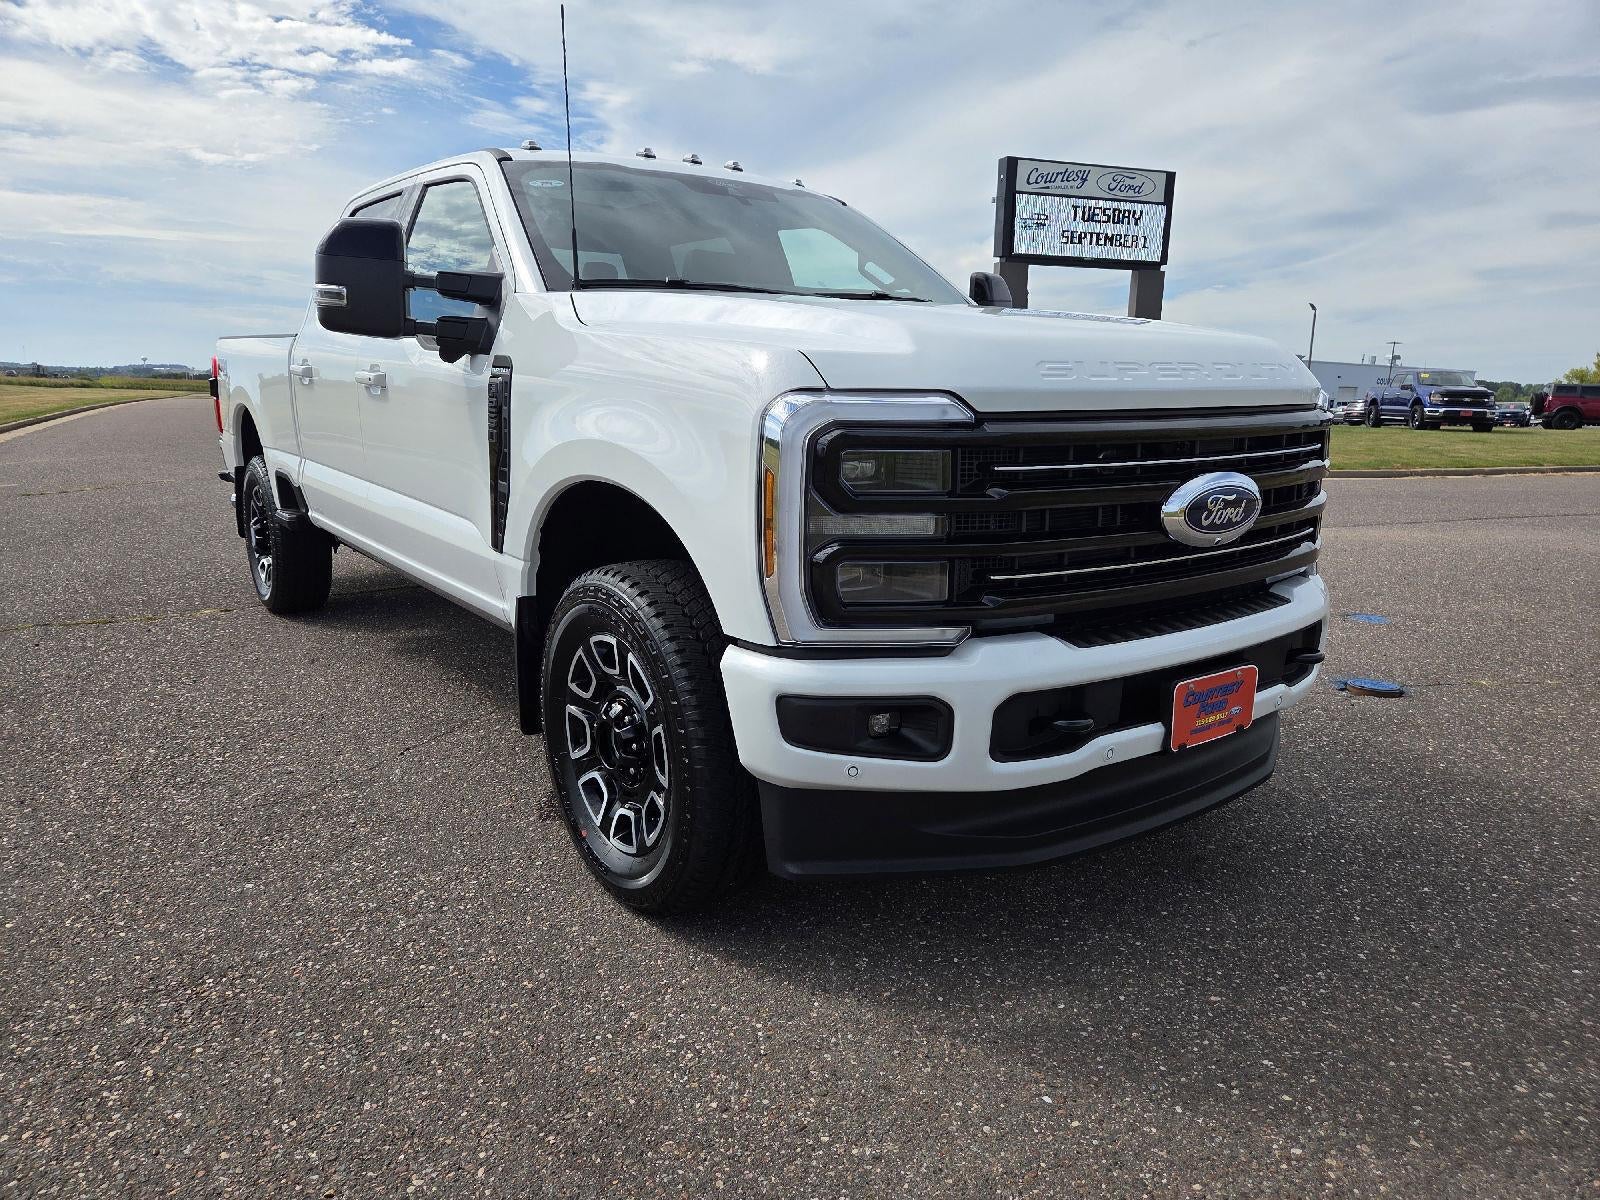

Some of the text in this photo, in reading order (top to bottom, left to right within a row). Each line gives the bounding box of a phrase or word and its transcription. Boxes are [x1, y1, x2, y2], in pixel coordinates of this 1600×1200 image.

[1026, 167, 1145, 194] Courtesy Ford
[1072, 204, 1143, 226] TUESDAY
[1061, 230, 1139, 248] SEPTEMBER
[1036, 360, 1212, 381] SUPER
[1201, 494, 1247, 526] Ford
